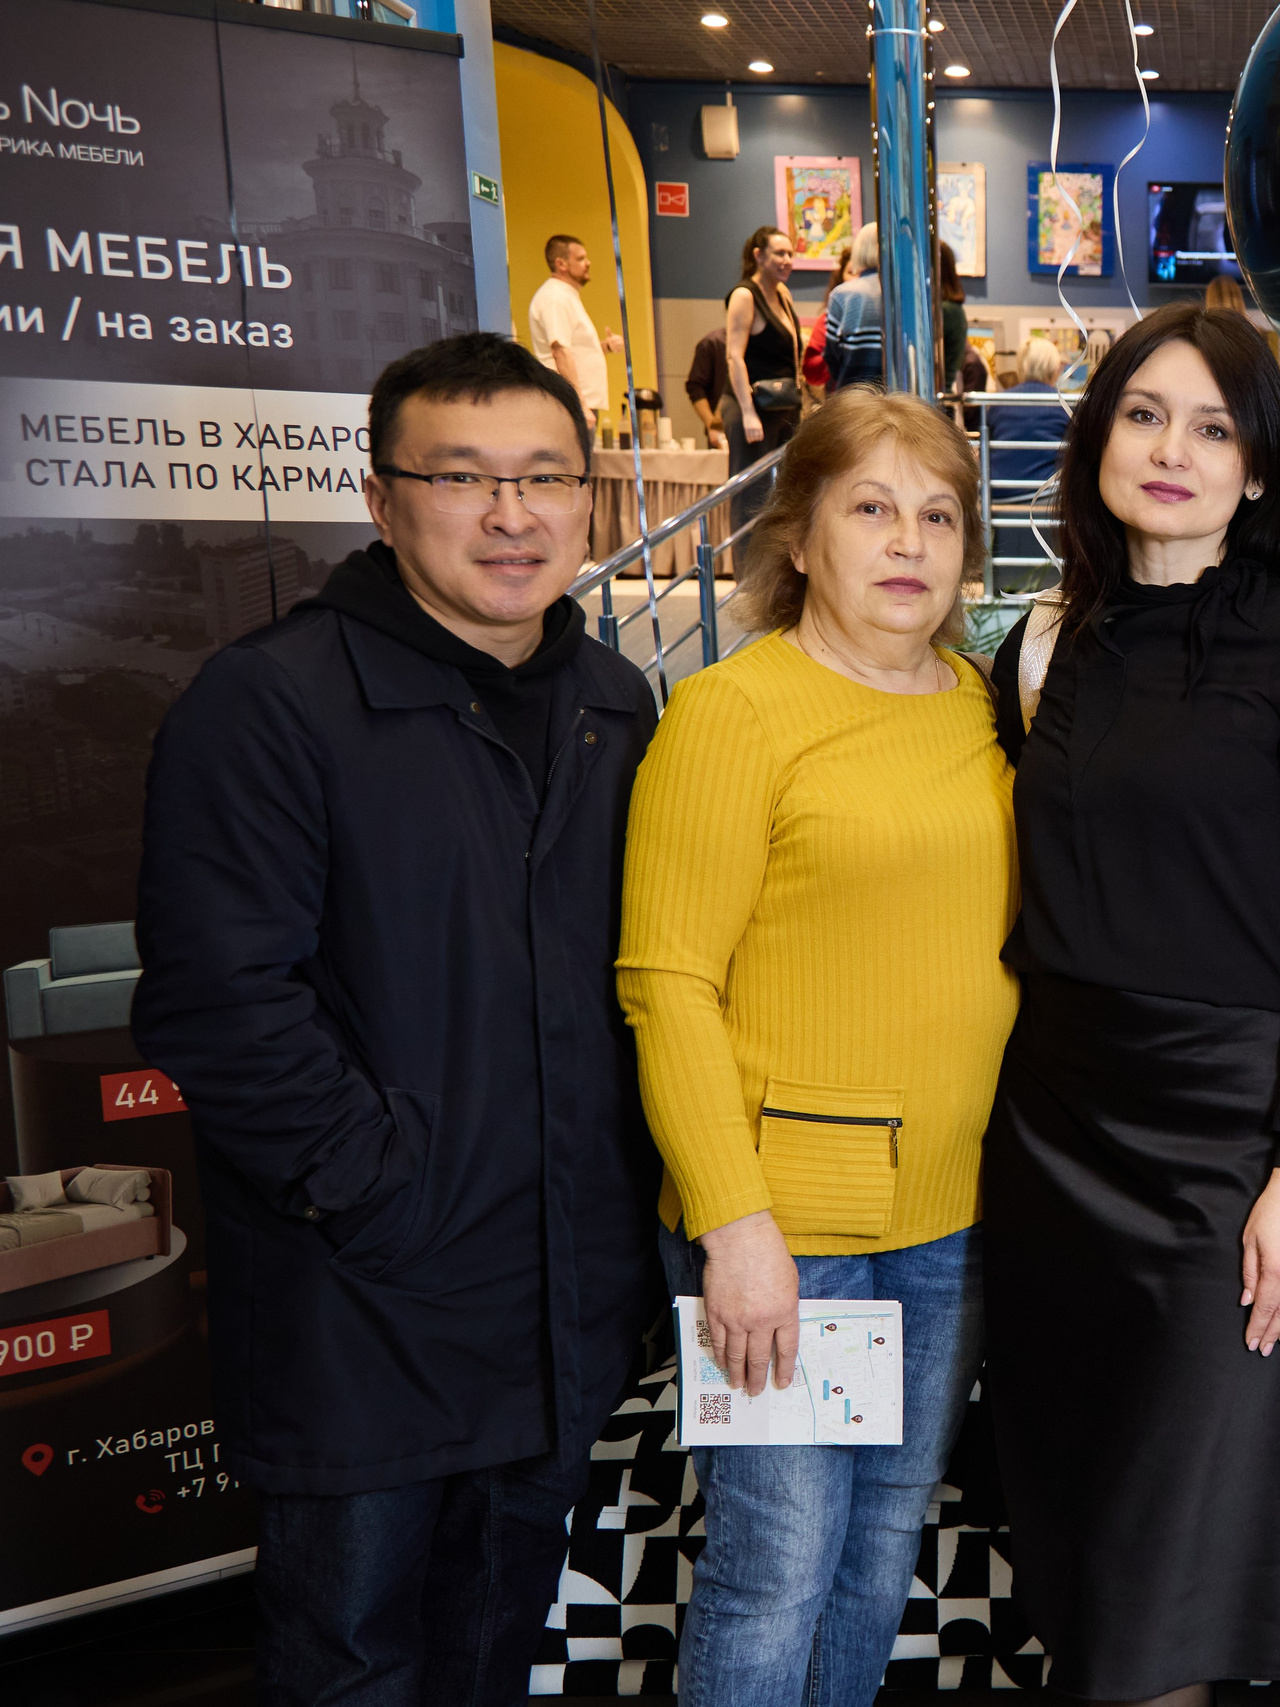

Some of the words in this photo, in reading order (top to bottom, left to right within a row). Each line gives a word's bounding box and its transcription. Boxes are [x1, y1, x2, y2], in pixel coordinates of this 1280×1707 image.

[59, 142, 145, 167] МЕБЕЛИ
[0, 224, 24, 269] Я
[47, 228, 293, 289] МЕБЕЛЬ
[98, 311, 153, 340] на
[169, 316, 294, 348] заказ
[20, 414, 186, 447] МЕБЕЛЬ
[199, 421, 223, 448] В
[233, 421, 371, 453] ХАБАРО
[26, 458, 157, 489] СТАЛА
[168, 462, 218, 490] ПО
[115, 1080, 159, 1108] 44
[70, 1324, 94, 1351] ₽
[67, 1449, 87, 1465] г.
[95, 1419, 216, 1459] Хабаров
[164, 1447, 204, 1472] ТЦ
[177, 1477, 206, 1498] +7
[216, 1472, 240, 1492] 9
